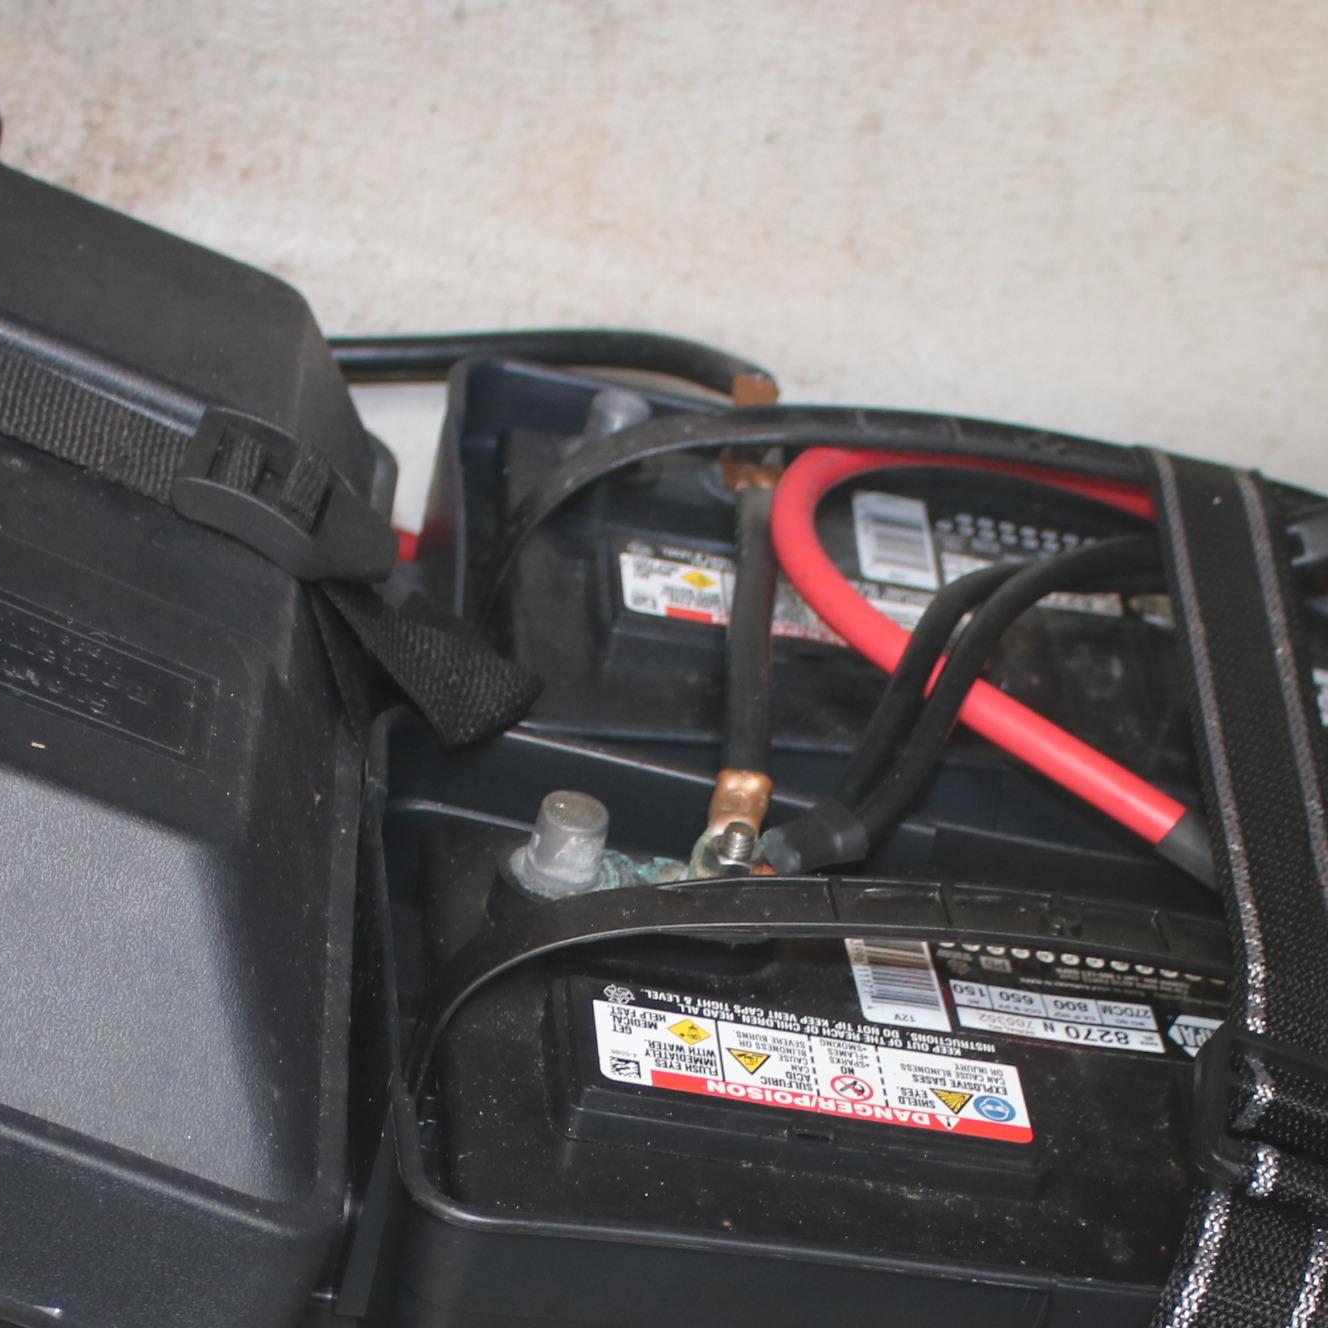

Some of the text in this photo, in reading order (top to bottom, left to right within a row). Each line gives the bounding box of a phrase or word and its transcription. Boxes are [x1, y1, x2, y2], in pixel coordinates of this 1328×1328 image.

[951, 983, 987, 996] 150
[695, 998, 729, 1010] TIGHT
[998, 991, 1033, 1005] 650
[677, 1003, 699, 1013] ALL
[733, 1004, 764, 1016] CAPS
[1052, 998, 1088, 1012] 800
[638, 1010, 666, 1022] HELP
[702, 1007, 735, 1020] READ
[767, 1009, 797, 1021] VENT
[609, 1014, 658, 1029] MEDICAL
[798, 1014, 828, 1027] KEEP
[1041, 1021, 1055, 1032] N
[610, 1023, 632, 1034] GET
[803, 1024, 819, 1033] OF
[820, 1026, 860, 1040] REACH
[856, 1024, 879, 1034] NOT
[882, 1028, 900, 1037] DO
[1063, 1023, 1130, 1046] 8270
[770, 1036, 806, 1048] SEVERE
[862, 1032, 885, 1044] THE
[886, 1036, 902, 1046] OF
[643, 1038, 716, 1057] WITH WATER.
[737, 1039, 807, 1056] BLINDNESS OR
[905, 1040, 929, 1051] OUT
[932, 1044, 961, 1056] KEEP
[643, 1048, 717, 1066] IMMEDIATELY
[777, 1054, 808, 1064] CAUSE
[653, 1058, 719, 1075] FLUSH EYES
[790, 1063, 809, 1072] CAN
[839, 1065, 855, 1075] NO
[989, 1068, 1003, 1076] OR
[785, 1071, 811, 1081] ACID
[899, 1062, 1005, 1085] CAN CAUSE BLINDNESS
[759, 1075, 813, 1091] SULFURIC
[911, 1073, 1007, 1095] EXPLOSIVE GASES
[707, 1080, 930, 1126] DANGER/POISON
[897, 1095, 936, 1109] SHIELD
